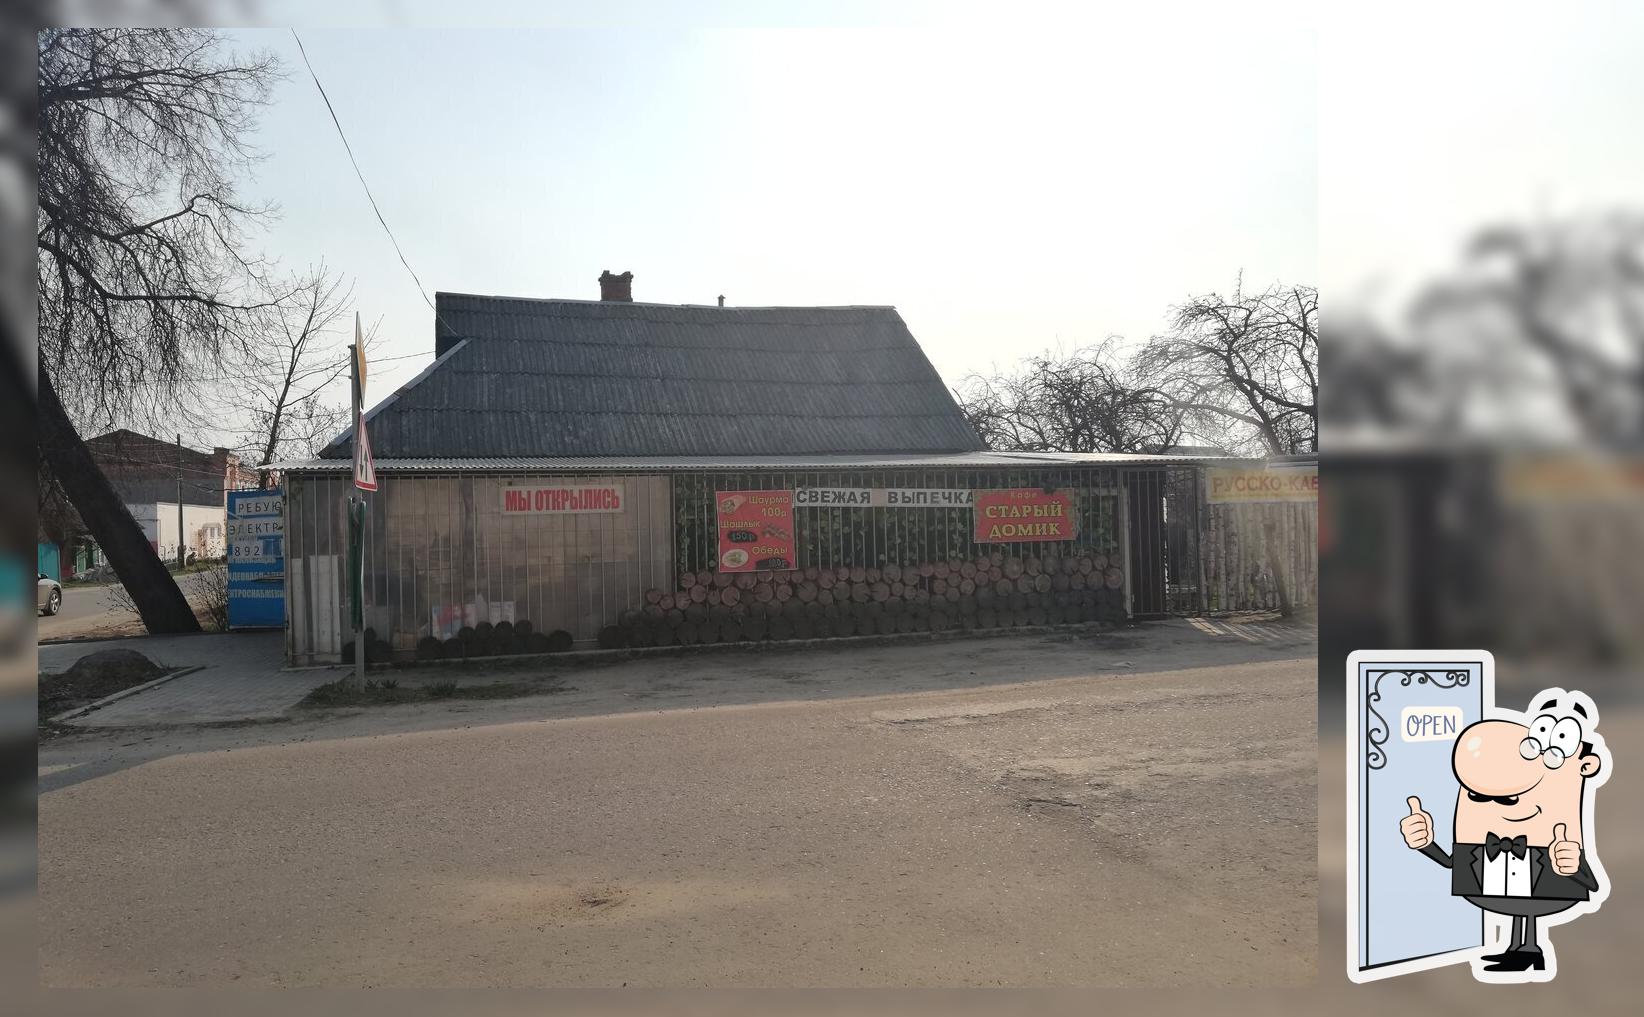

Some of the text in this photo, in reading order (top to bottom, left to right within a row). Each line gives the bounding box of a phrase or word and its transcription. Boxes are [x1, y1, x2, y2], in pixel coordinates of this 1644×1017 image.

[505, 488, 620, 511] МЫ ОТКРЫЛИСЬ
[749, 496, 789, 505] Шаурма
[796, 490, 973, 504] СВЕЖАЯ ВЫПЕЧКА
[985, 501, 1063, 518] СТАРЫЙ
[720, 520, 761, 529] Шашлык
[989, 523, 1061, 539] ДОМИК
[752, 546, 788, 555] Обеды
